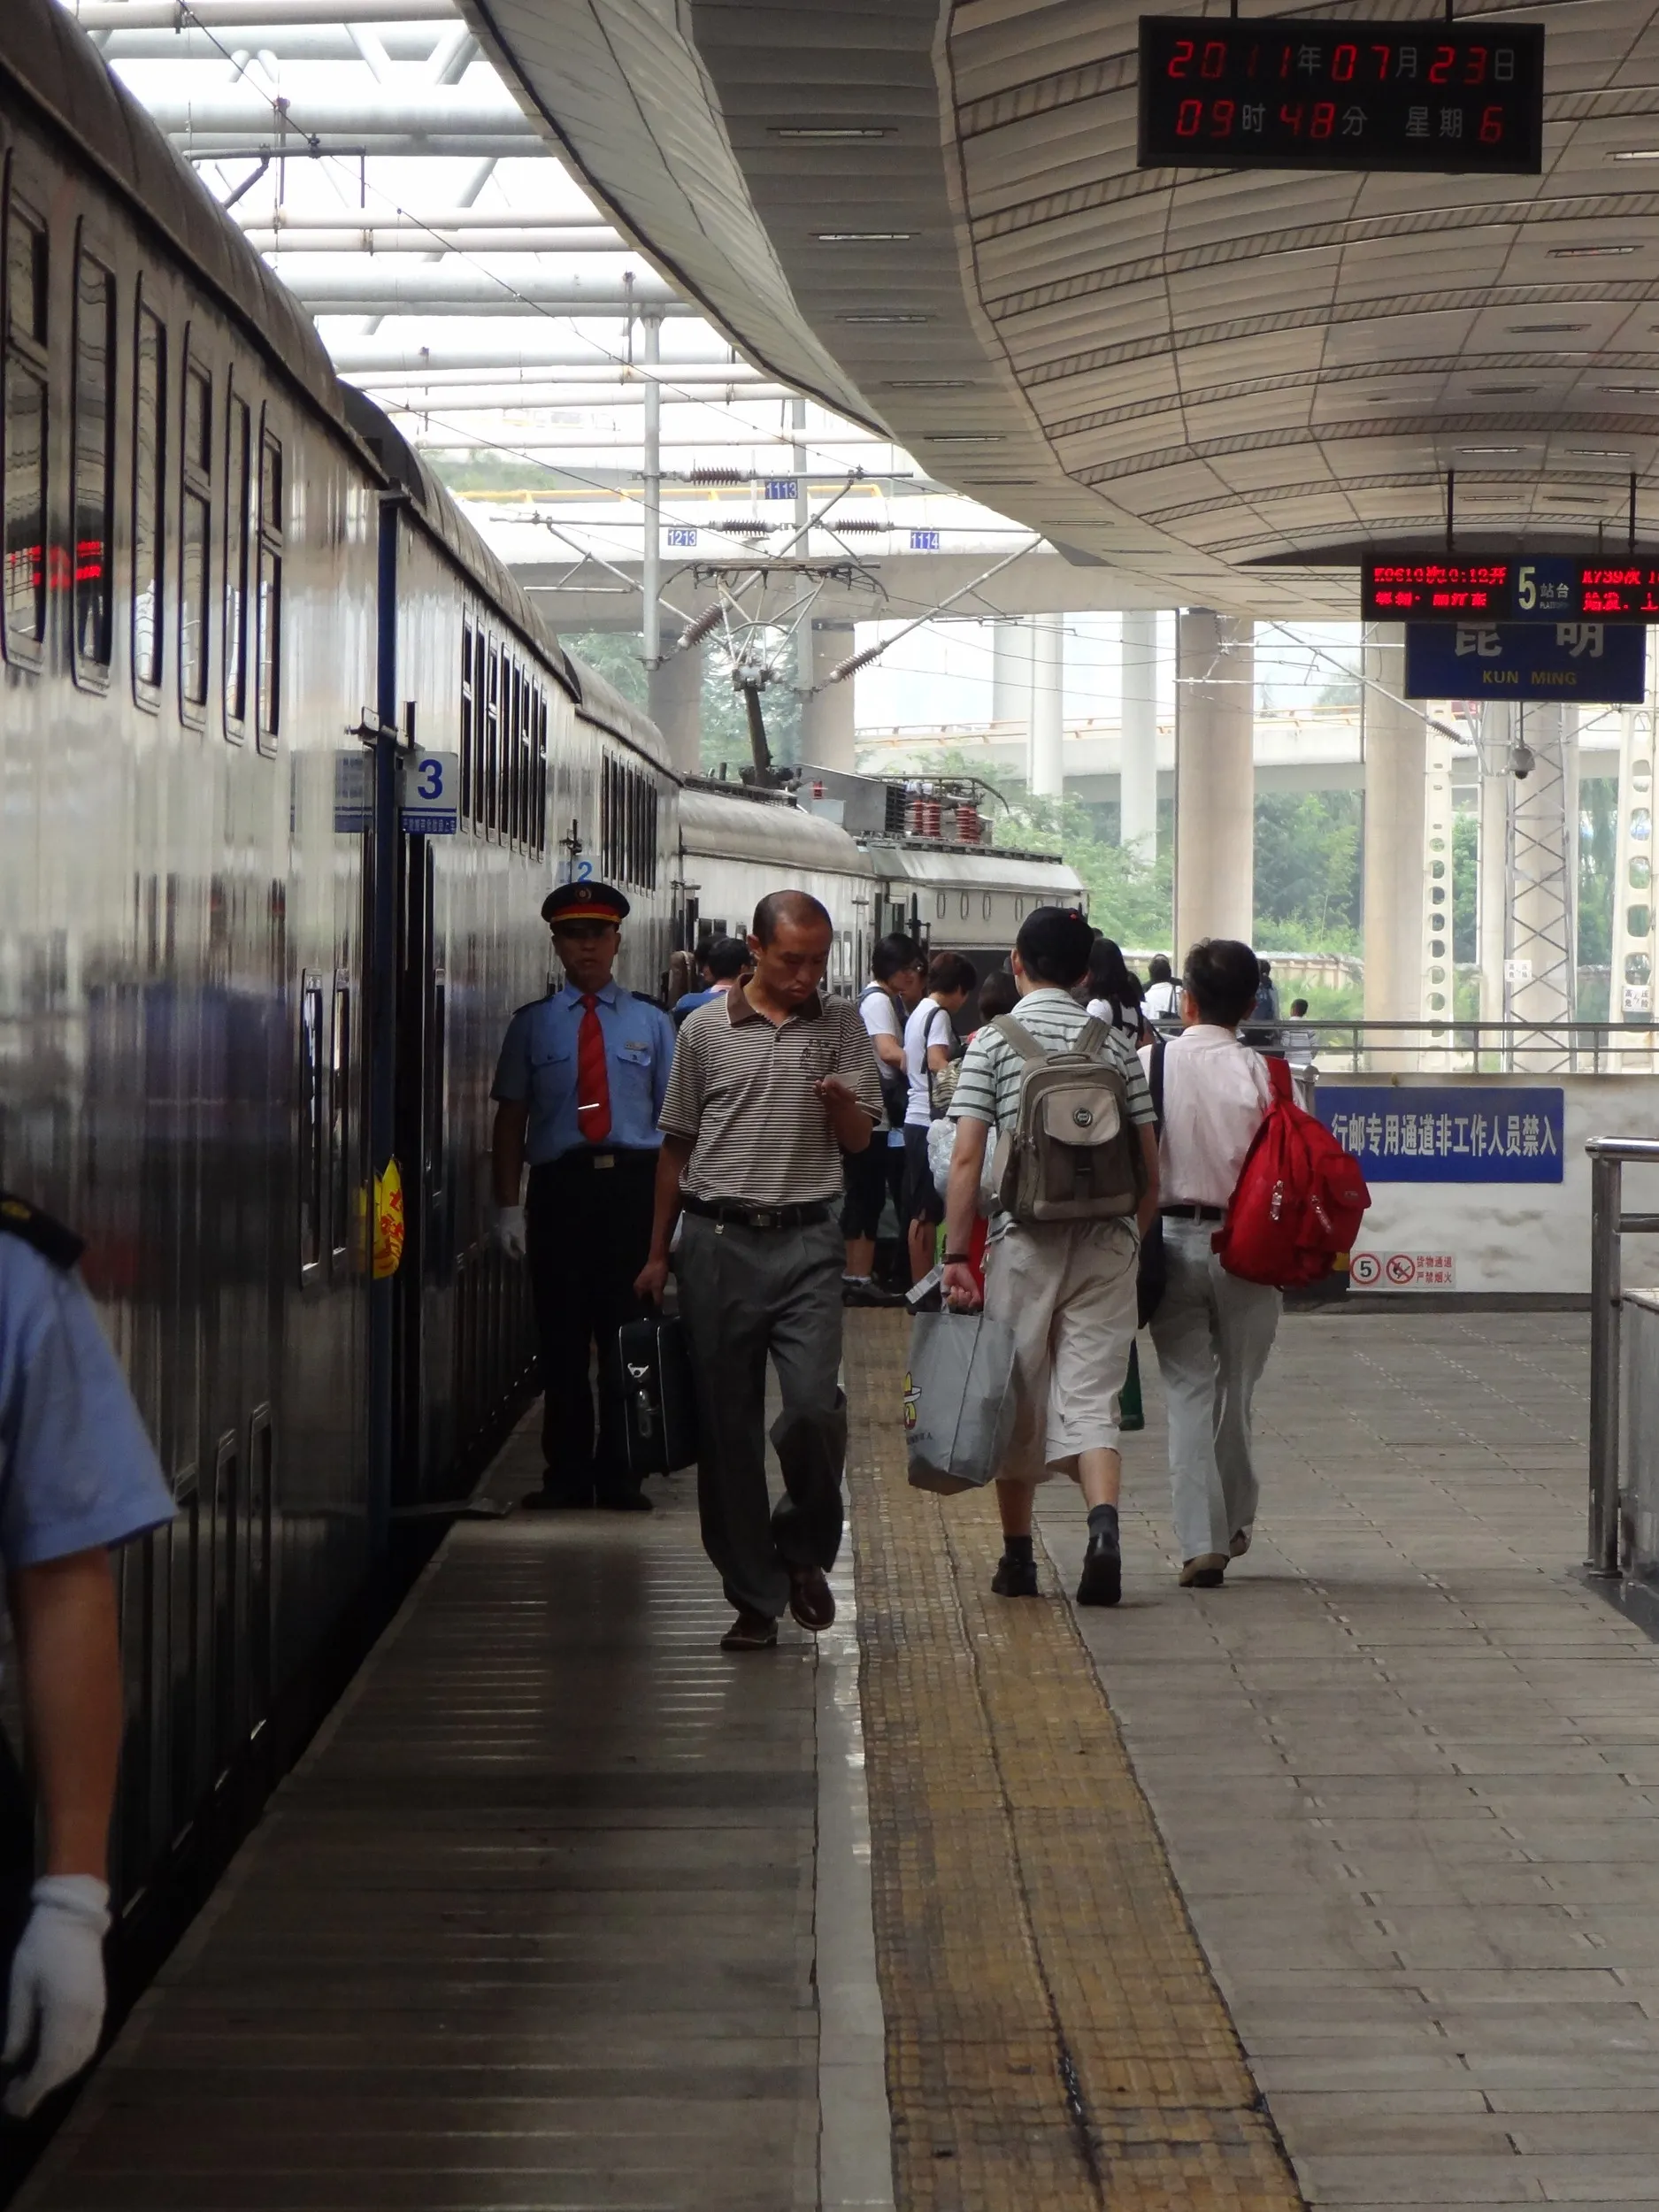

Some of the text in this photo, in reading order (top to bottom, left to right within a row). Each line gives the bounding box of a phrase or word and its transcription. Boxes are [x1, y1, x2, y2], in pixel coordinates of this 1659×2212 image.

[1175, 99, 1503, 142] 09时48分 星期6
[767, 482, 795, 499] 1113
[669, 530, 696, 546] 1213
[911, 532, 940, 549] 1114
[1518, 566, 1536, 610] 5
[1540, 582, 1570, 598] 站台
[1483, 670, 1578, 686] KUN MING
[417, 758, 443, 800] 3
[578, 861, 593, 883] 2
[1331, 1112, 1557, 1157] 行邮专用通道非工作人员禁入
[1360, 1261, 1372, 1278] 5
